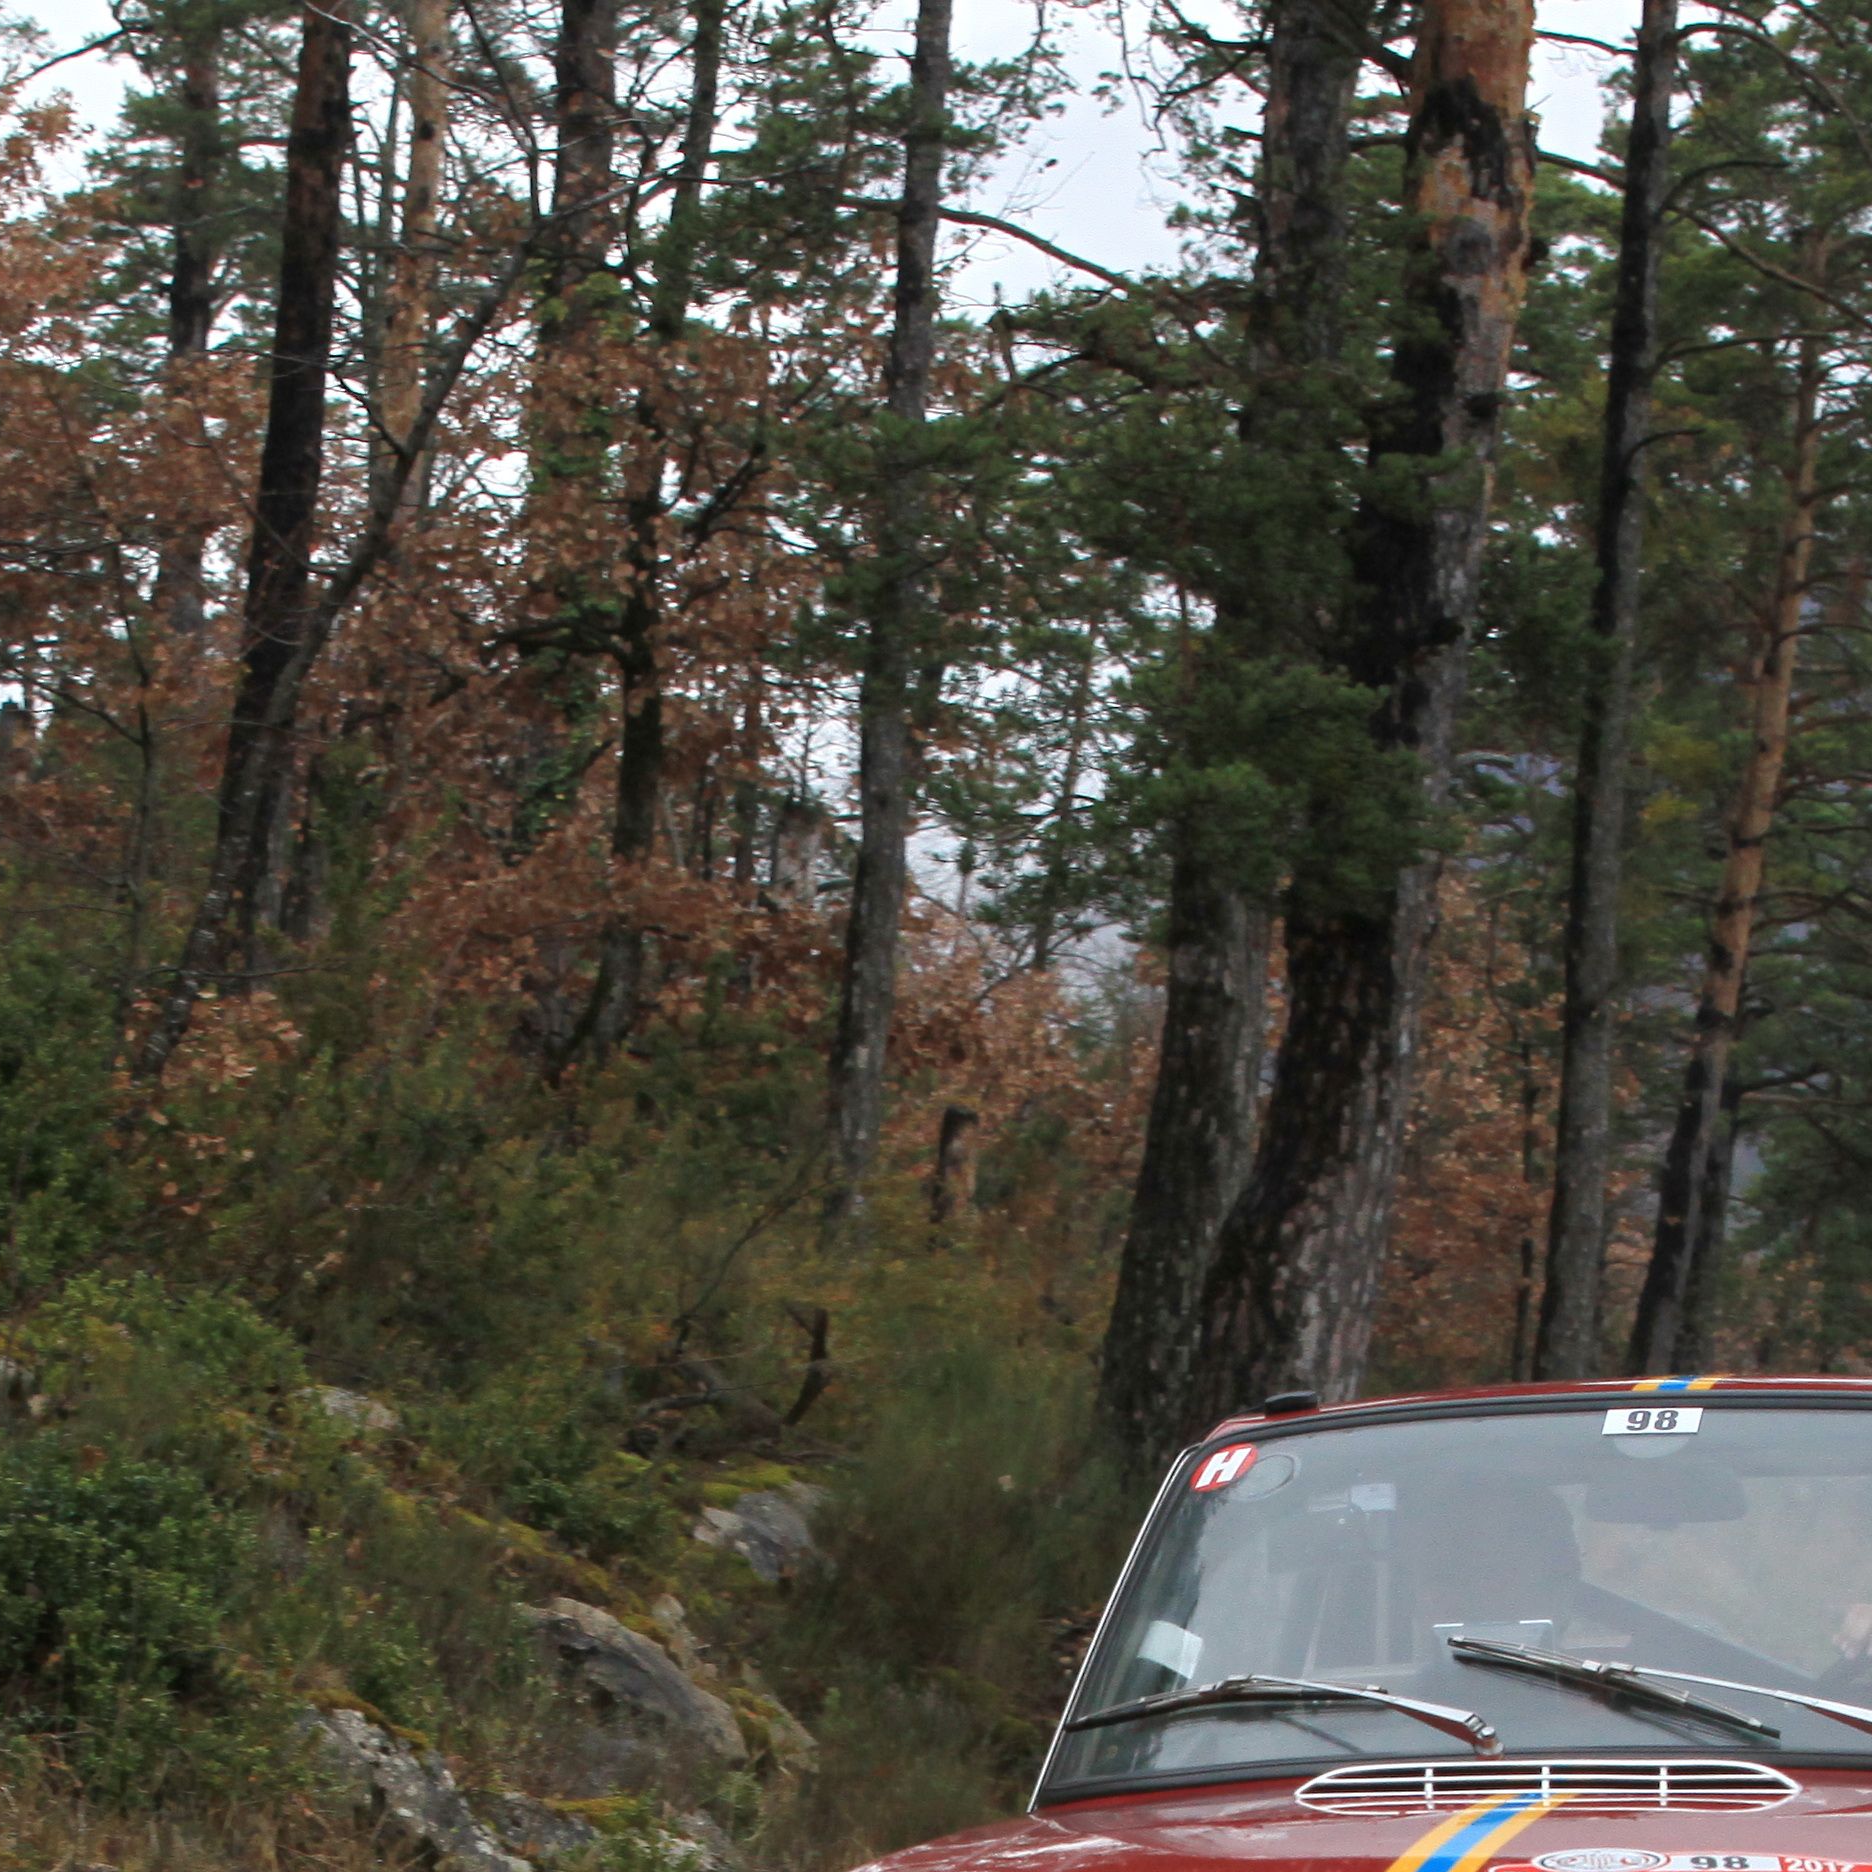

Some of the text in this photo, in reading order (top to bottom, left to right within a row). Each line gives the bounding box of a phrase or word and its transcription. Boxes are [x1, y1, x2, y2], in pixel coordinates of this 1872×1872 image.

[1626, 1409, 1679, 1431] 98
[1195, 1447, 1252, 1489] H
[1690, 1856, 1855, 1872] 98 2017
